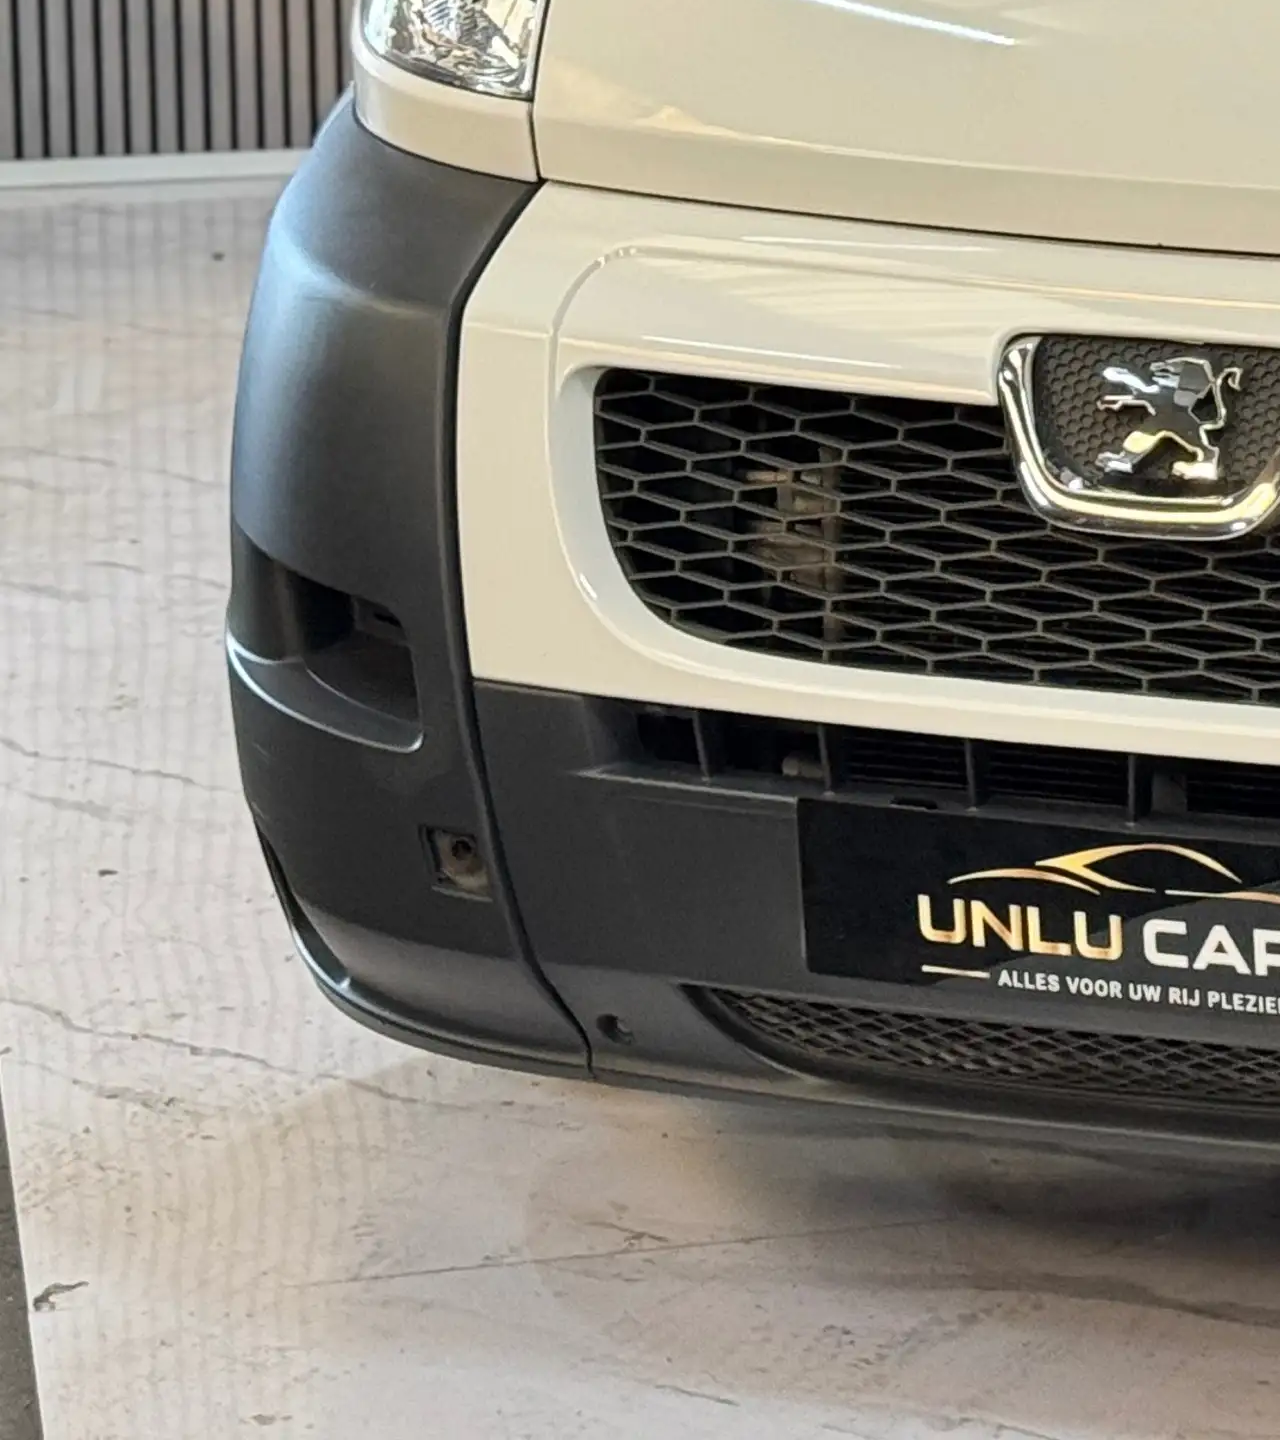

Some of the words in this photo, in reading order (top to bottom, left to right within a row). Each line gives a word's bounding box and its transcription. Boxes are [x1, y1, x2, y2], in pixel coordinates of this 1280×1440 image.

[917, 894, 1123, 961] UNLU
[997, 969, 1061, 992] ALLES
[1065, 975, 1123, 999] VOOR
[1128, 982, 1162, 1003] UW
[1168, 986, 1201, 1007] RIJ
